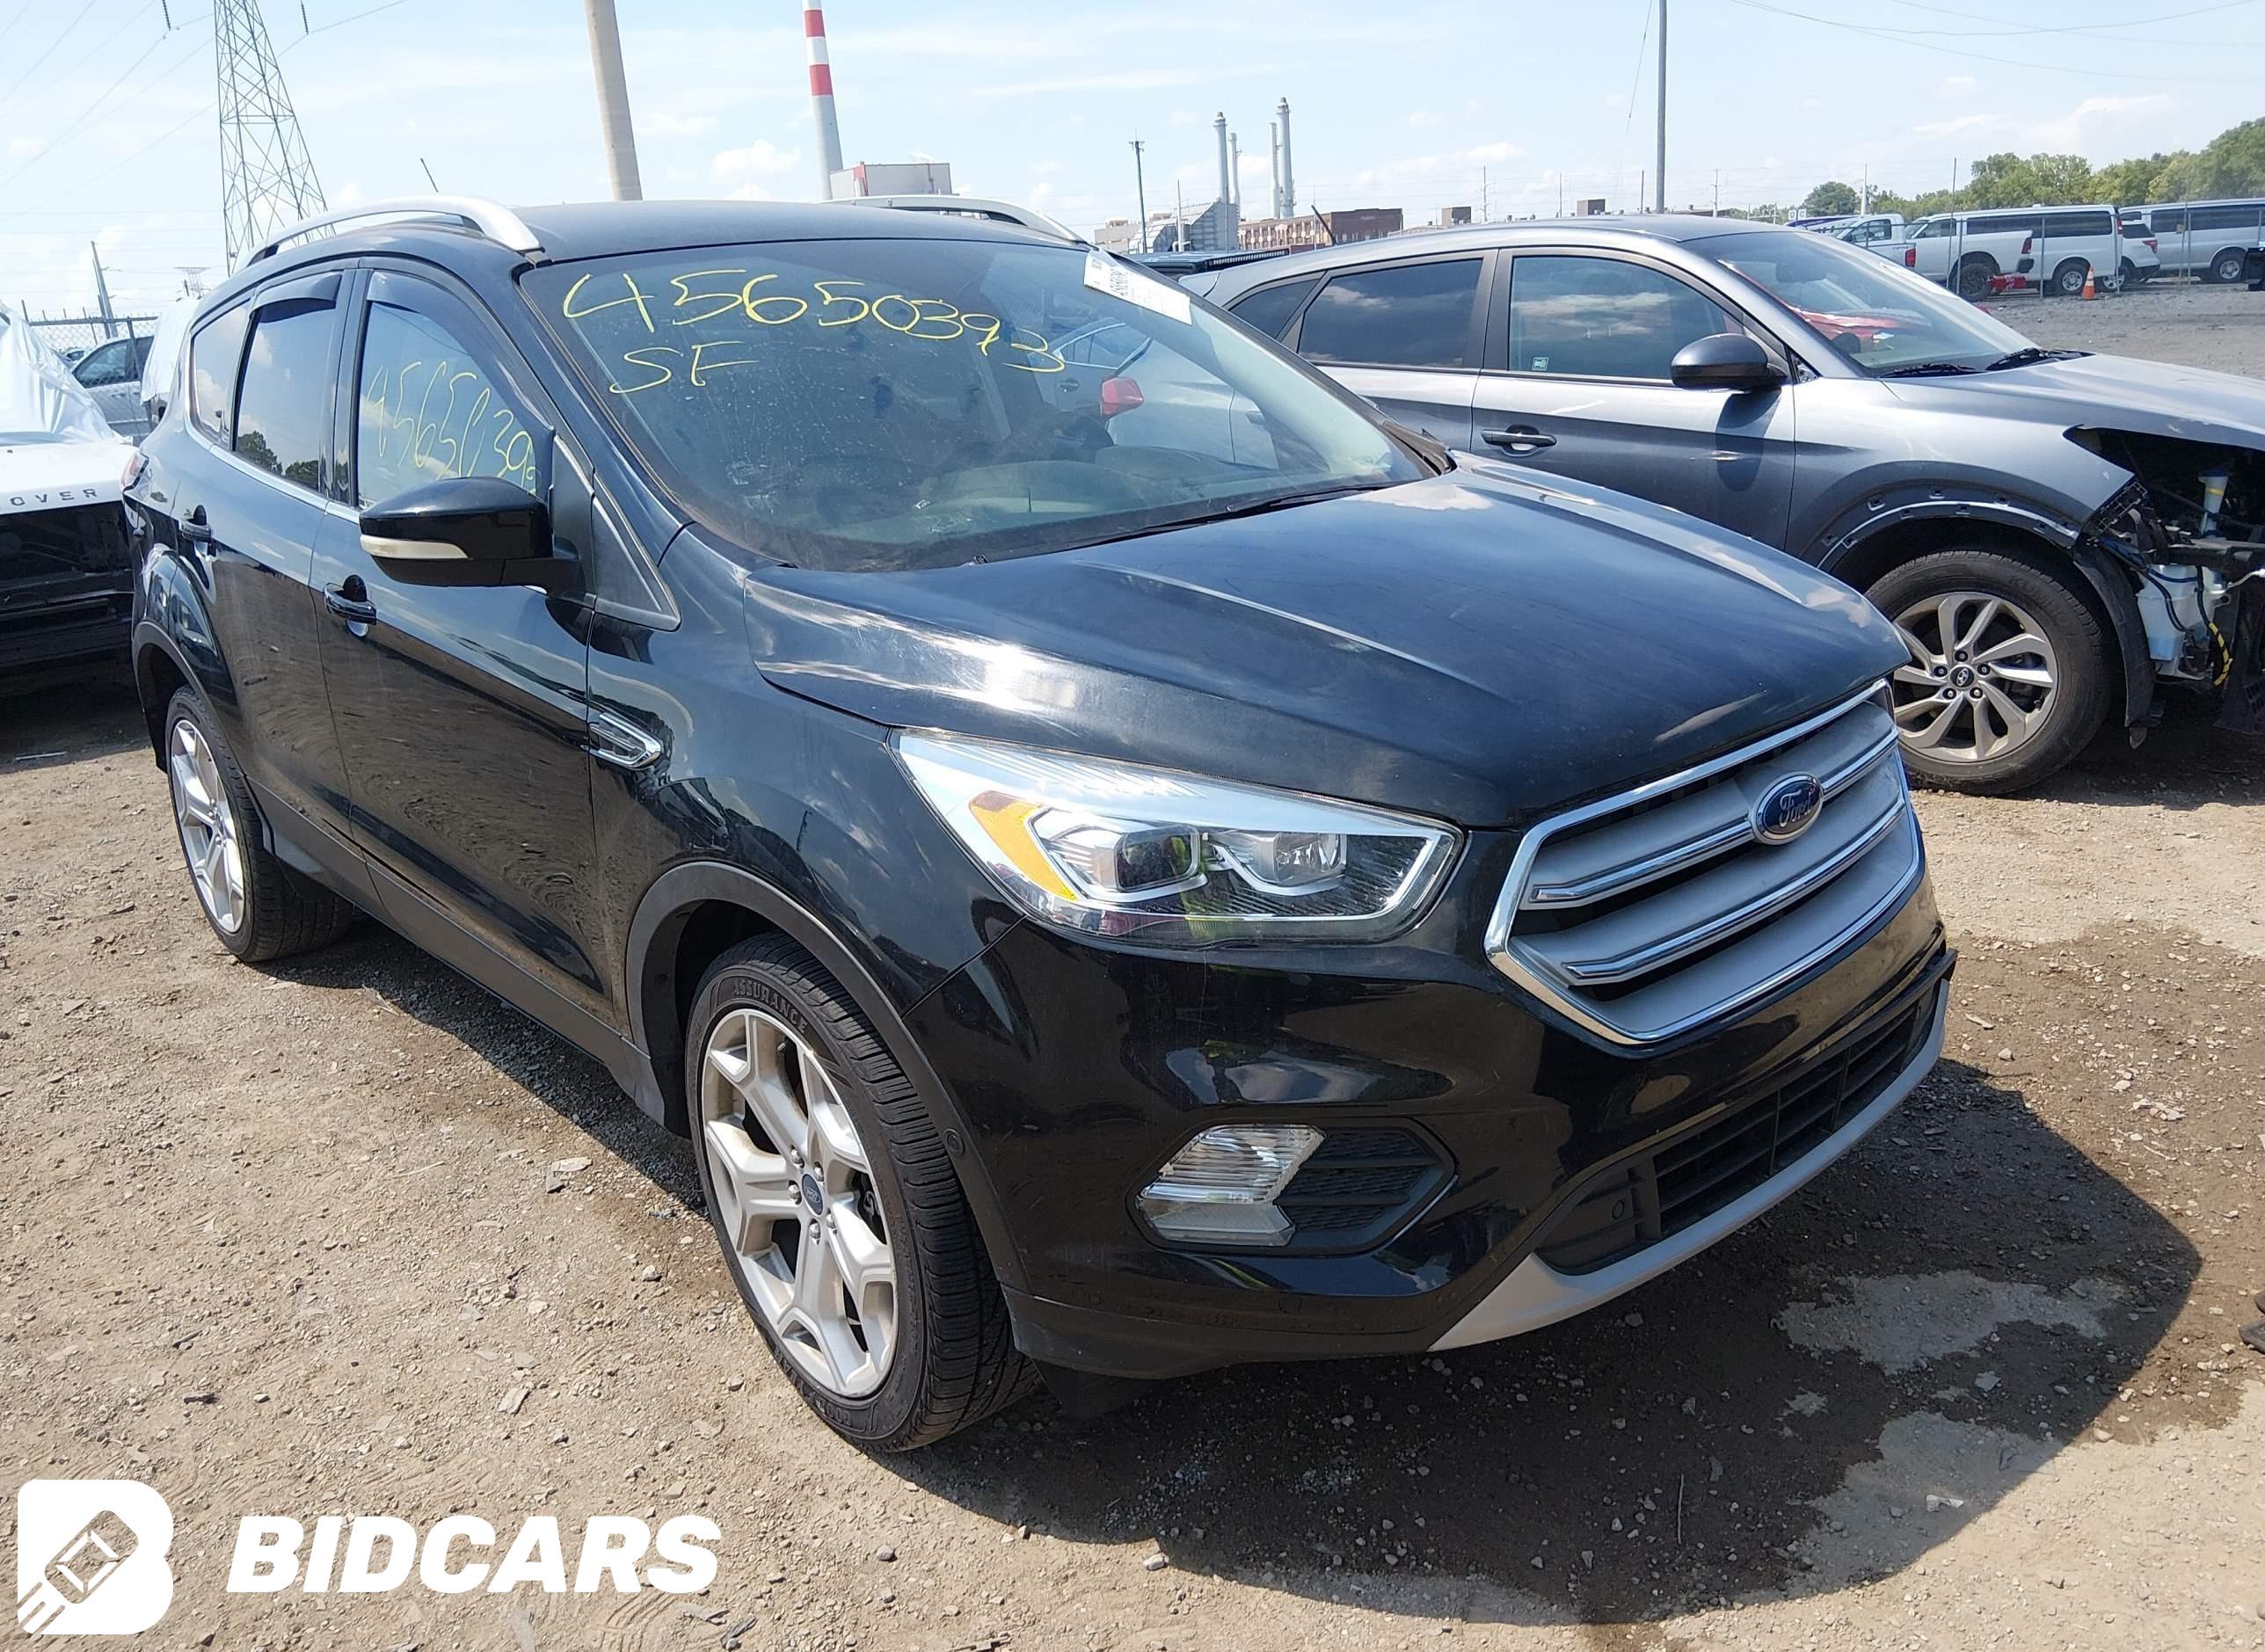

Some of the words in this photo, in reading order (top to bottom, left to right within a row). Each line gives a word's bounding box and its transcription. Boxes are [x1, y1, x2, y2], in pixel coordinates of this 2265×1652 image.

[563, 269, 1067, 373] 45650393
[609, 340, 758, 394] SF
[10, 488, 98, 506] OVER
[1779, 788, 1816, 827] Ford
[732, 978, 808, 1034] ASSURANCE
